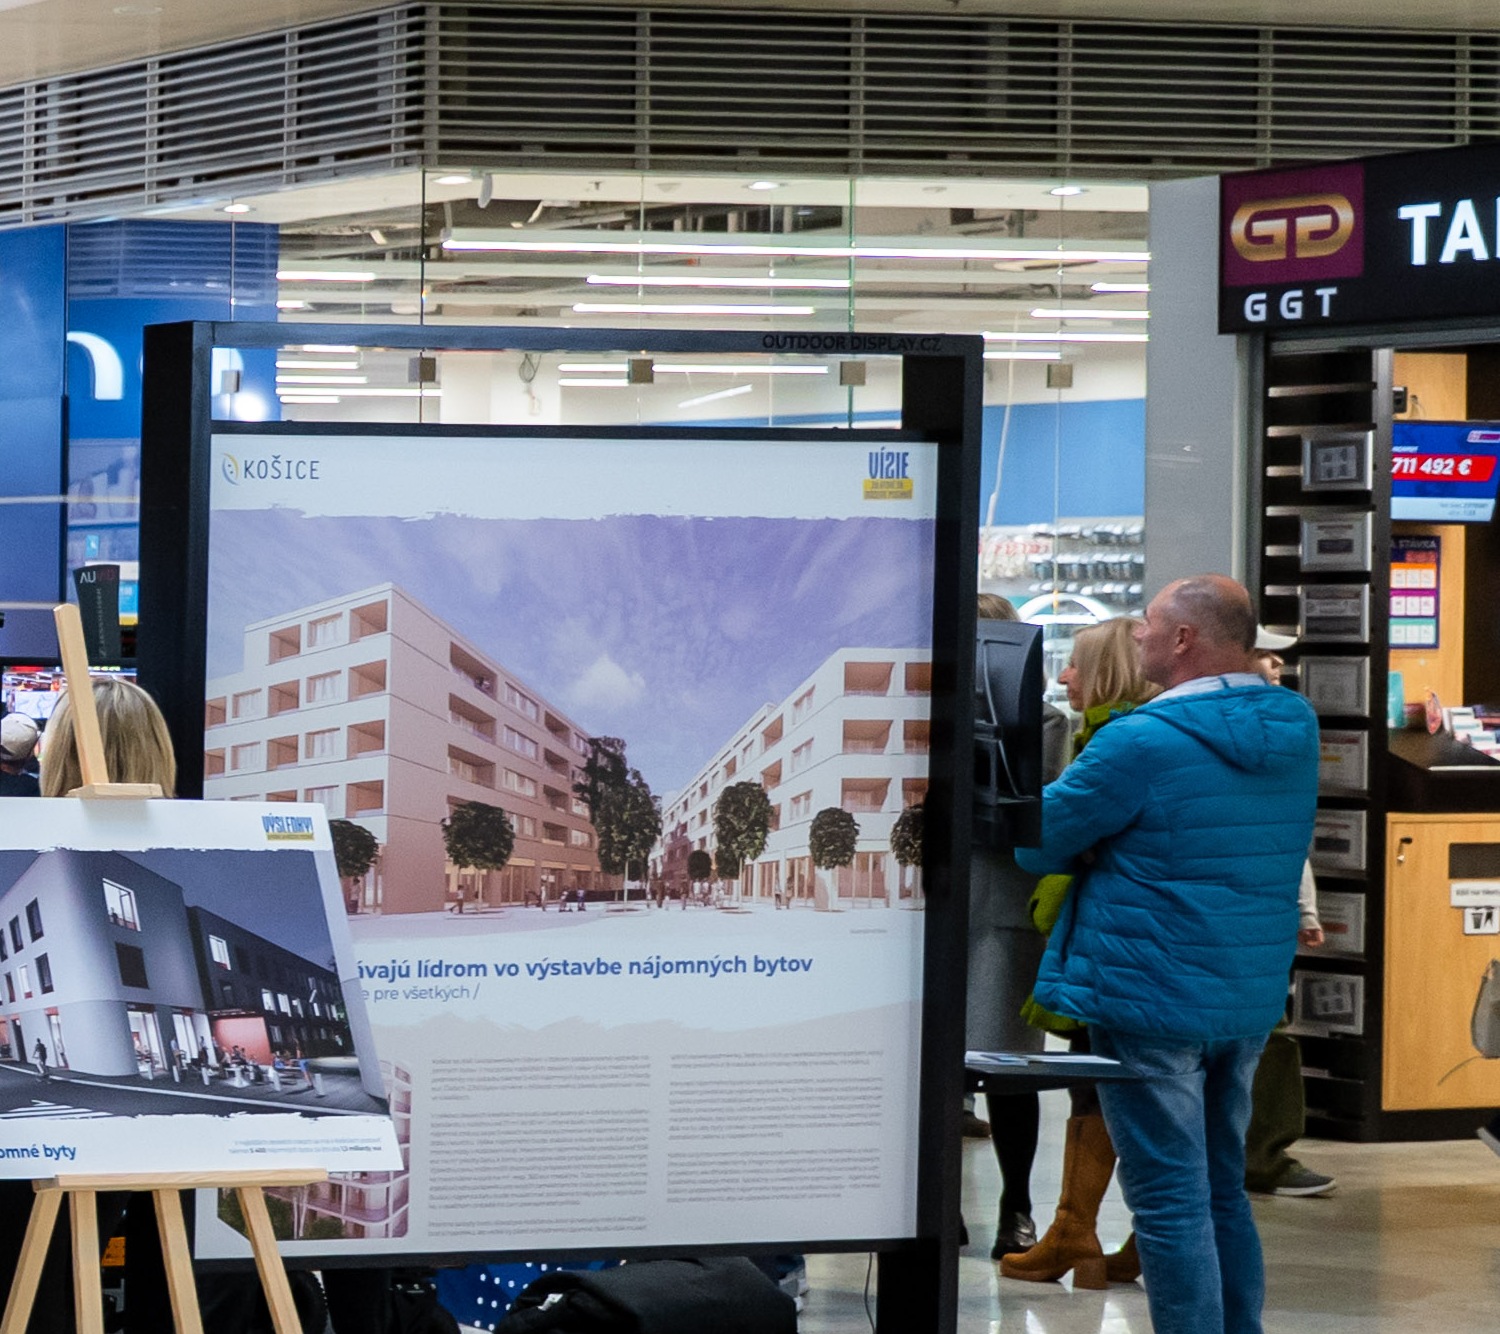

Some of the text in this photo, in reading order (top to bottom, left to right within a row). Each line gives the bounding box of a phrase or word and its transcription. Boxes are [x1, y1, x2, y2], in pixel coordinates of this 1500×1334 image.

[1397, 196, 1500, 266] TA
[1244, 286, 1338, 323] GGT
[762, 334, 941, 352] OUTDOOR DISPLAY.CZ
[244, 455, 320, 480] KOŠICE
[868, 446, 909, 479] VÍZIE
[1420, 458, 1454, 475] 492
[1457, 459, 1472, 475] €
[417, 959, 487, 979] lídrom
[494, 963, 520, 977] vo
[525, 957, 622, 981] výstavbe
[629, 953, 744, 979] nájomných
[753, 954, 813, 975] bytov
[373, 990, 399, 1006] pre
[402, 984, 470, 1003] všetkých
[43, 1144, 77, 1164] byty
